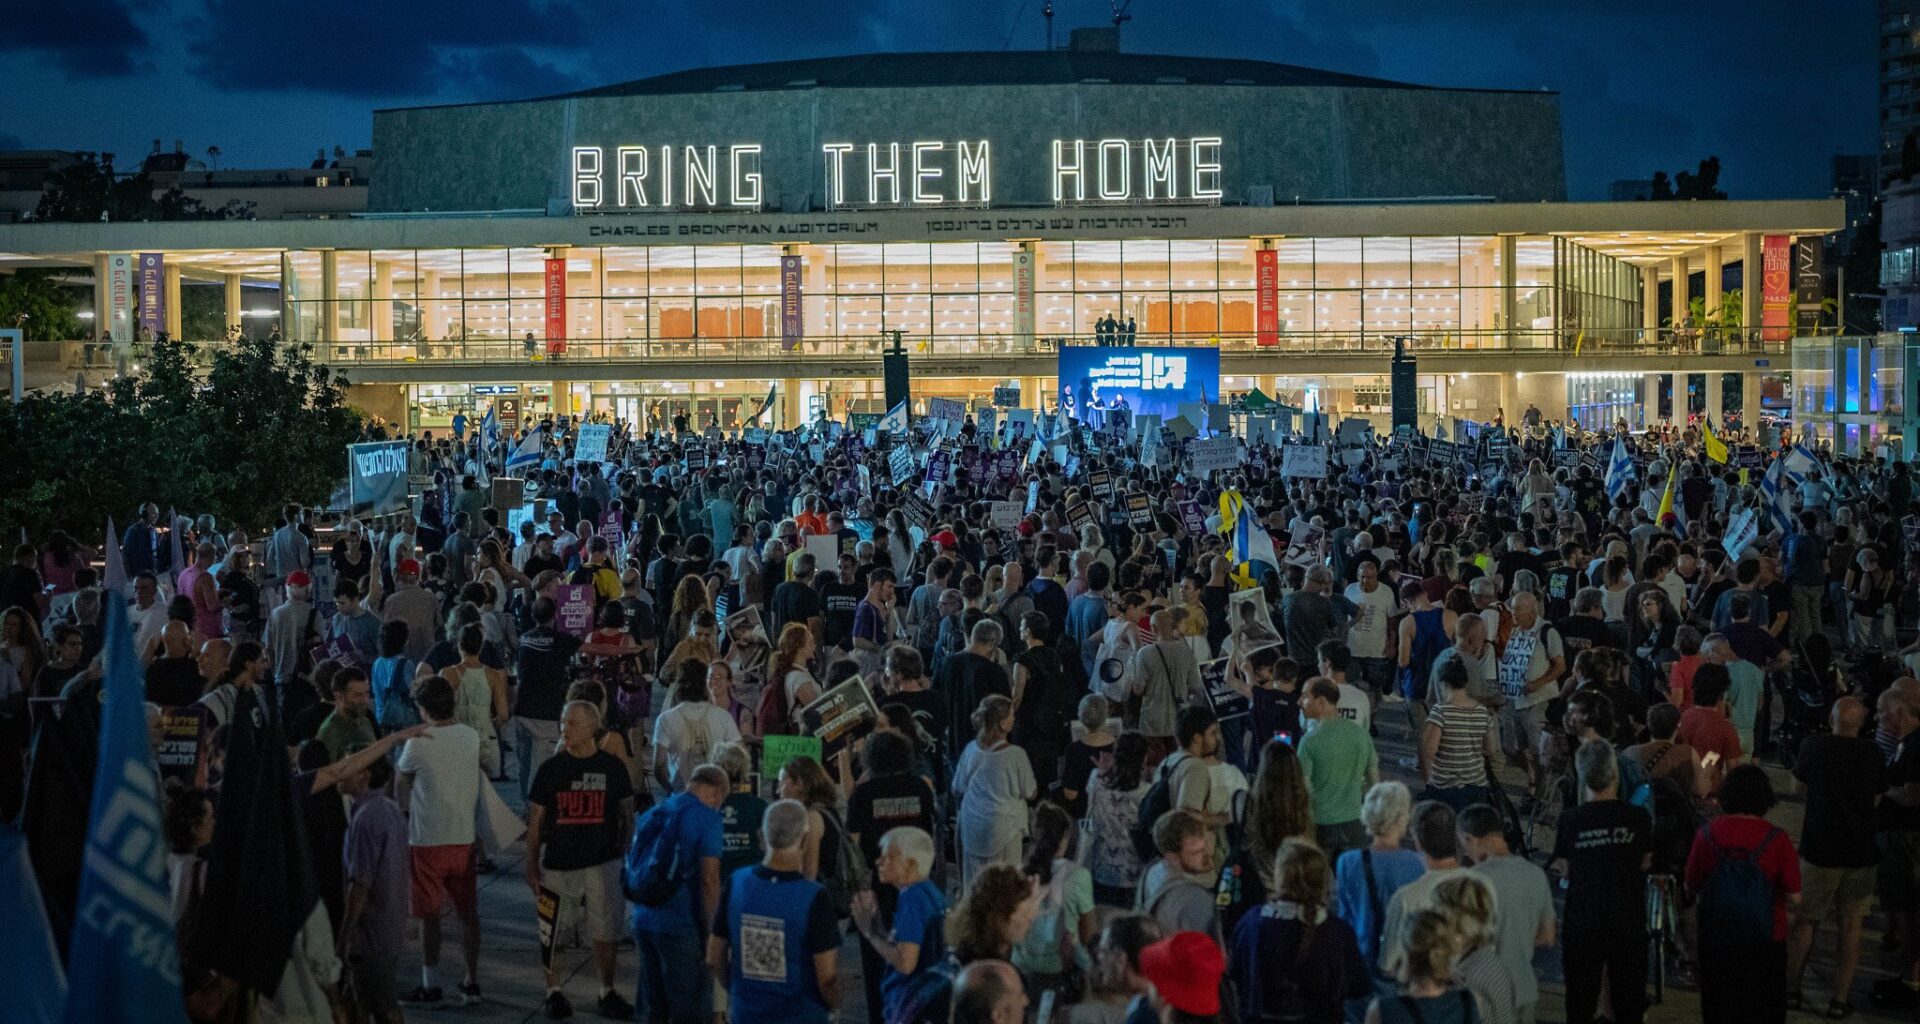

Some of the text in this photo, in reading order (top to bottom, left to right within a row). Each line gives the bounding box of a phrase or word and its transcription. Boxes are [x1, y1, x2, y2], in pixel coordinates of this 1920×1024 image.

[572, 137, 1222, 208] BRING THEM HOME
[926, 219, 992, 234] ברונפמן
[1079, 218, 1143, 229] התרבות
[1147, 216, 1186, 228] היכל
[589, 222, 878, 237] CHARLES BRONFMAN AUDITORIUM
[1764, 258, 1789, 271] אהבה
[1799, 242, 1821, 280] JAZZ
[1507, 637, 1535, 651] אתה
[1501, 653, 1532, 666] הראש
[1500, 667, 1527, 682] אתה
